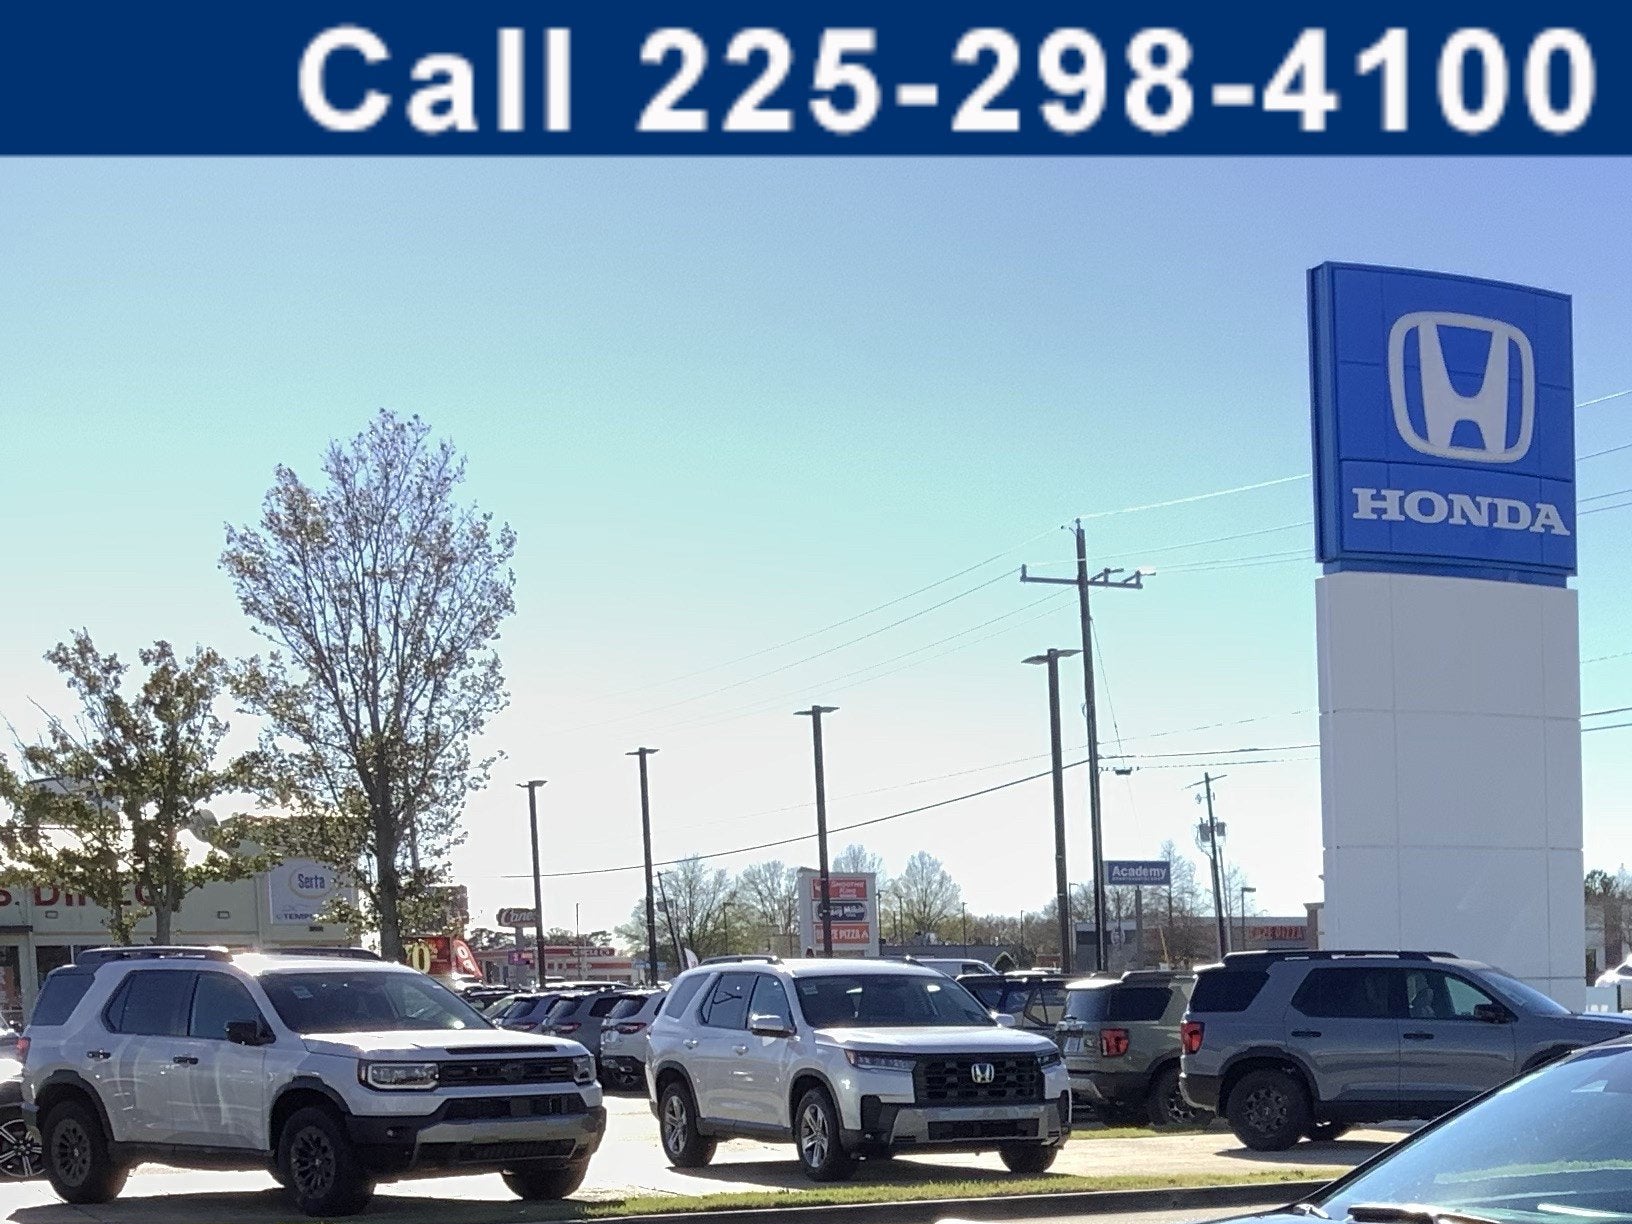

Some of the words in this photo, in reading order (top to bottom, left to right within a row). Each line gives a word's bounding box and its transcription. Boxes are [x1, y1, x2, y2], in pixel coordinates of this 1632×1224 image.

[1352, 488, 1571, 537] HONDA
[1112, 866, 1167, 880] Academy
[298, 874, 325, 889] Serta
